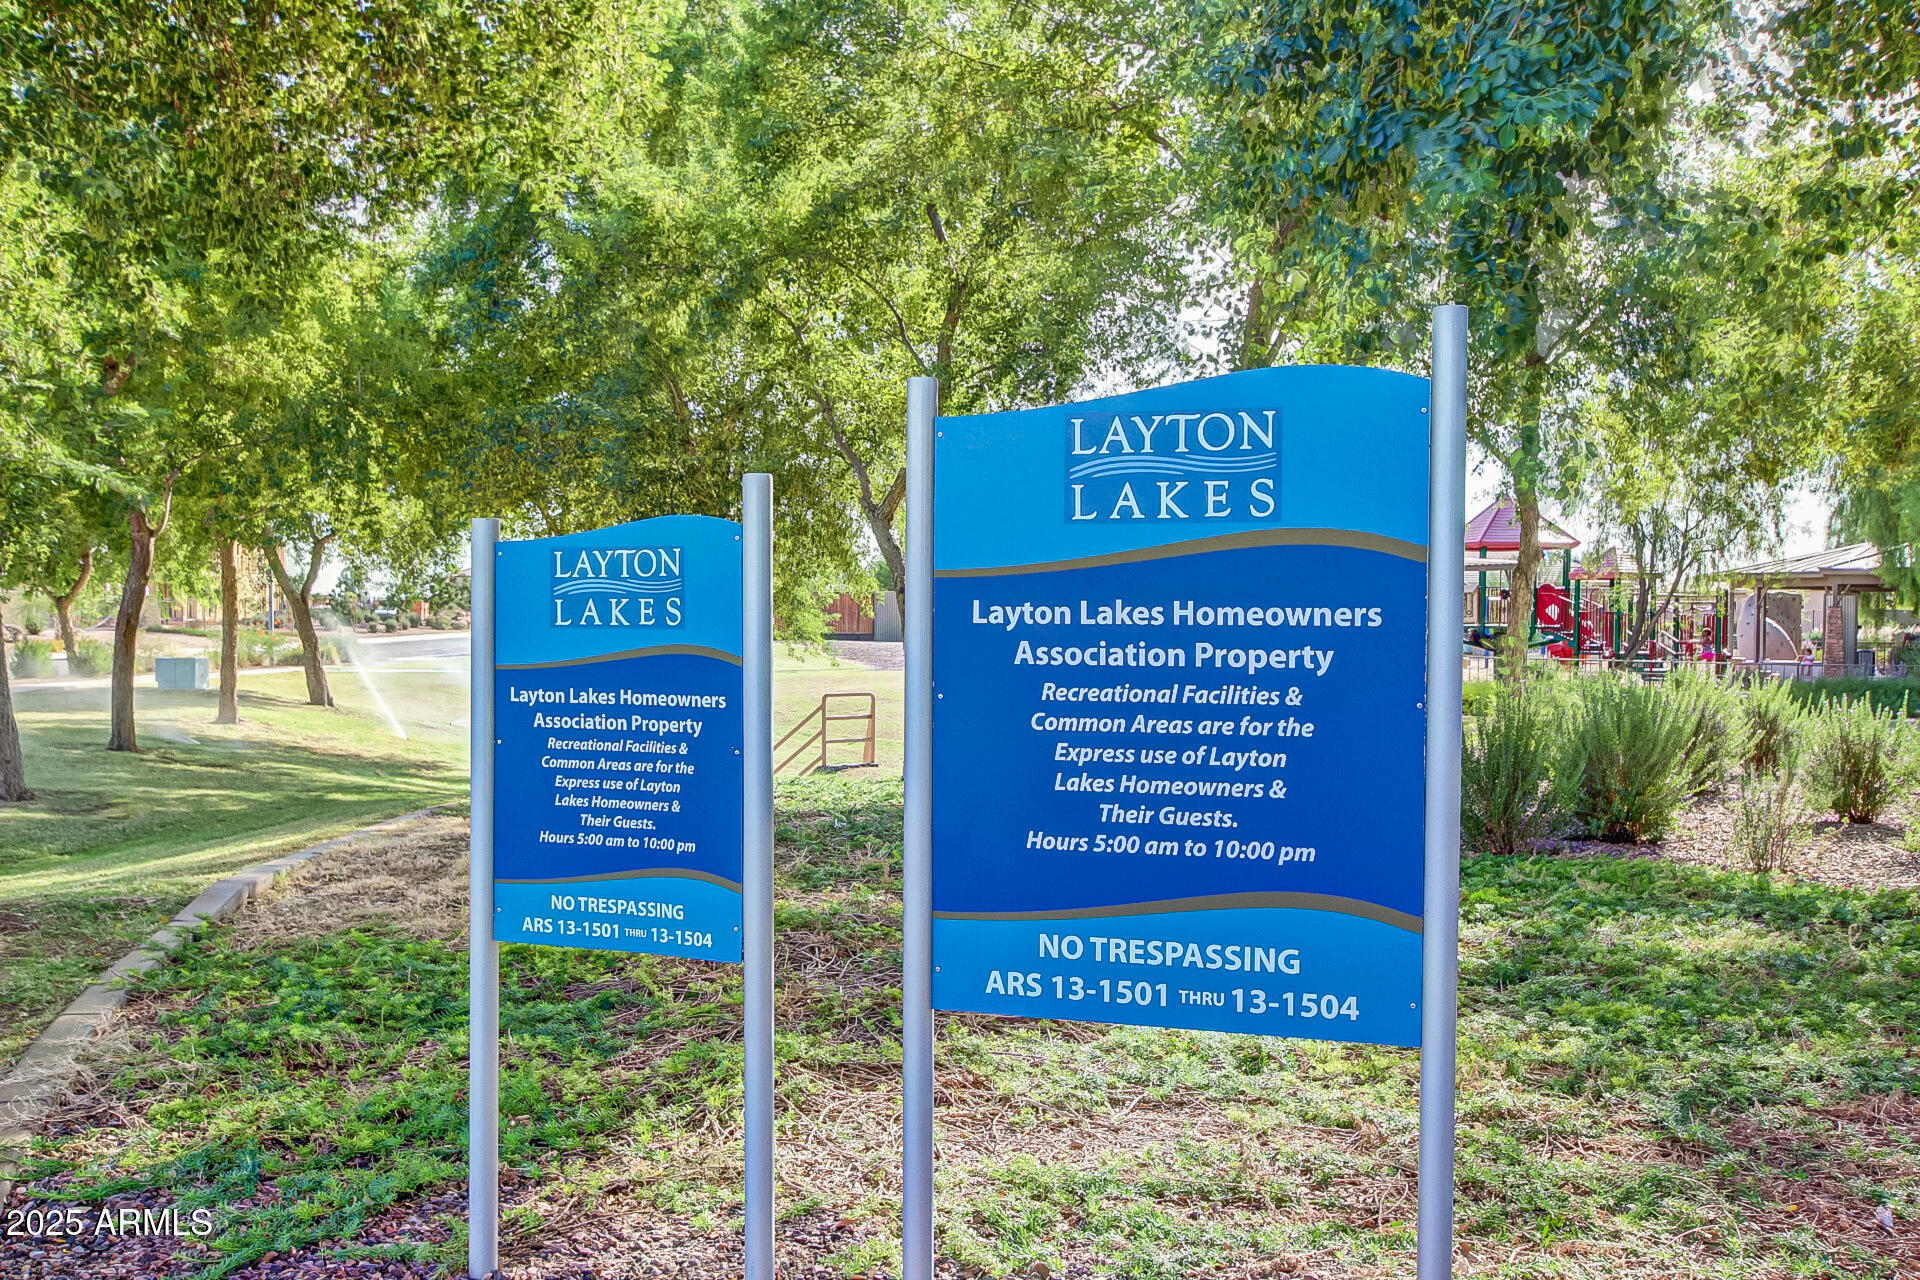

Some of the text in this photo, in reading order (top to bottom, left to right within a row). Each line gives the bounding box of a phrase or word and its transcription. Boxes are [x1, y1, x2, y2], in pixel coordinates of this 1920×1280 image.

[1070, 410, 1276, 455] LAYTON
[1071, 478, 1275, 520] LAKES
[553, 547, 681, 578] LAYTON
[554, 597, 682, 626] LAKES
[972, 599, 1382, 632] Layton Lakes Homeowners
[1013, 640, 1335, 677] Association Property
[510, 686, 727, 709] Layton Lakes Homeowners
[1041, 682, 1304, 706] Recreational Facilities &
[533, 712, 703, 738] Association Property
[1030, 712, 1315, 738] Common Areas are for the
[547, 736, 689, 755] Recreational Facilities &
[1054, 742, 1287, 772] Express use of Layton
[541, 755, 695, 775] Common Areas are for the
[554, 774, 681, 795] Express use of Layton
[1054, 772, 1288, 799] Lakes Homeowners &
[554, 793, 681, 813] Lakes Homeowners &
[1099, 803, 1238, 828] Their Guests.
[580, 813, 656, 830] Their Guests.
[539, 830, 696, 855] Hours 5:00 am to 10:00 pm
[1026, 830, 1316, 866] Hours 5:00 am to 10:00 pm
[551, 894, 684, 920] NO TRESPASSING
[522, 916, 713, 948] ARS 13-1501 THRU 13-1504
[1039, 933, 1300, 975] NO TRESPASSING
[985, 970, 1360, 1021] ARS 13-1501 THRU 13-1504
